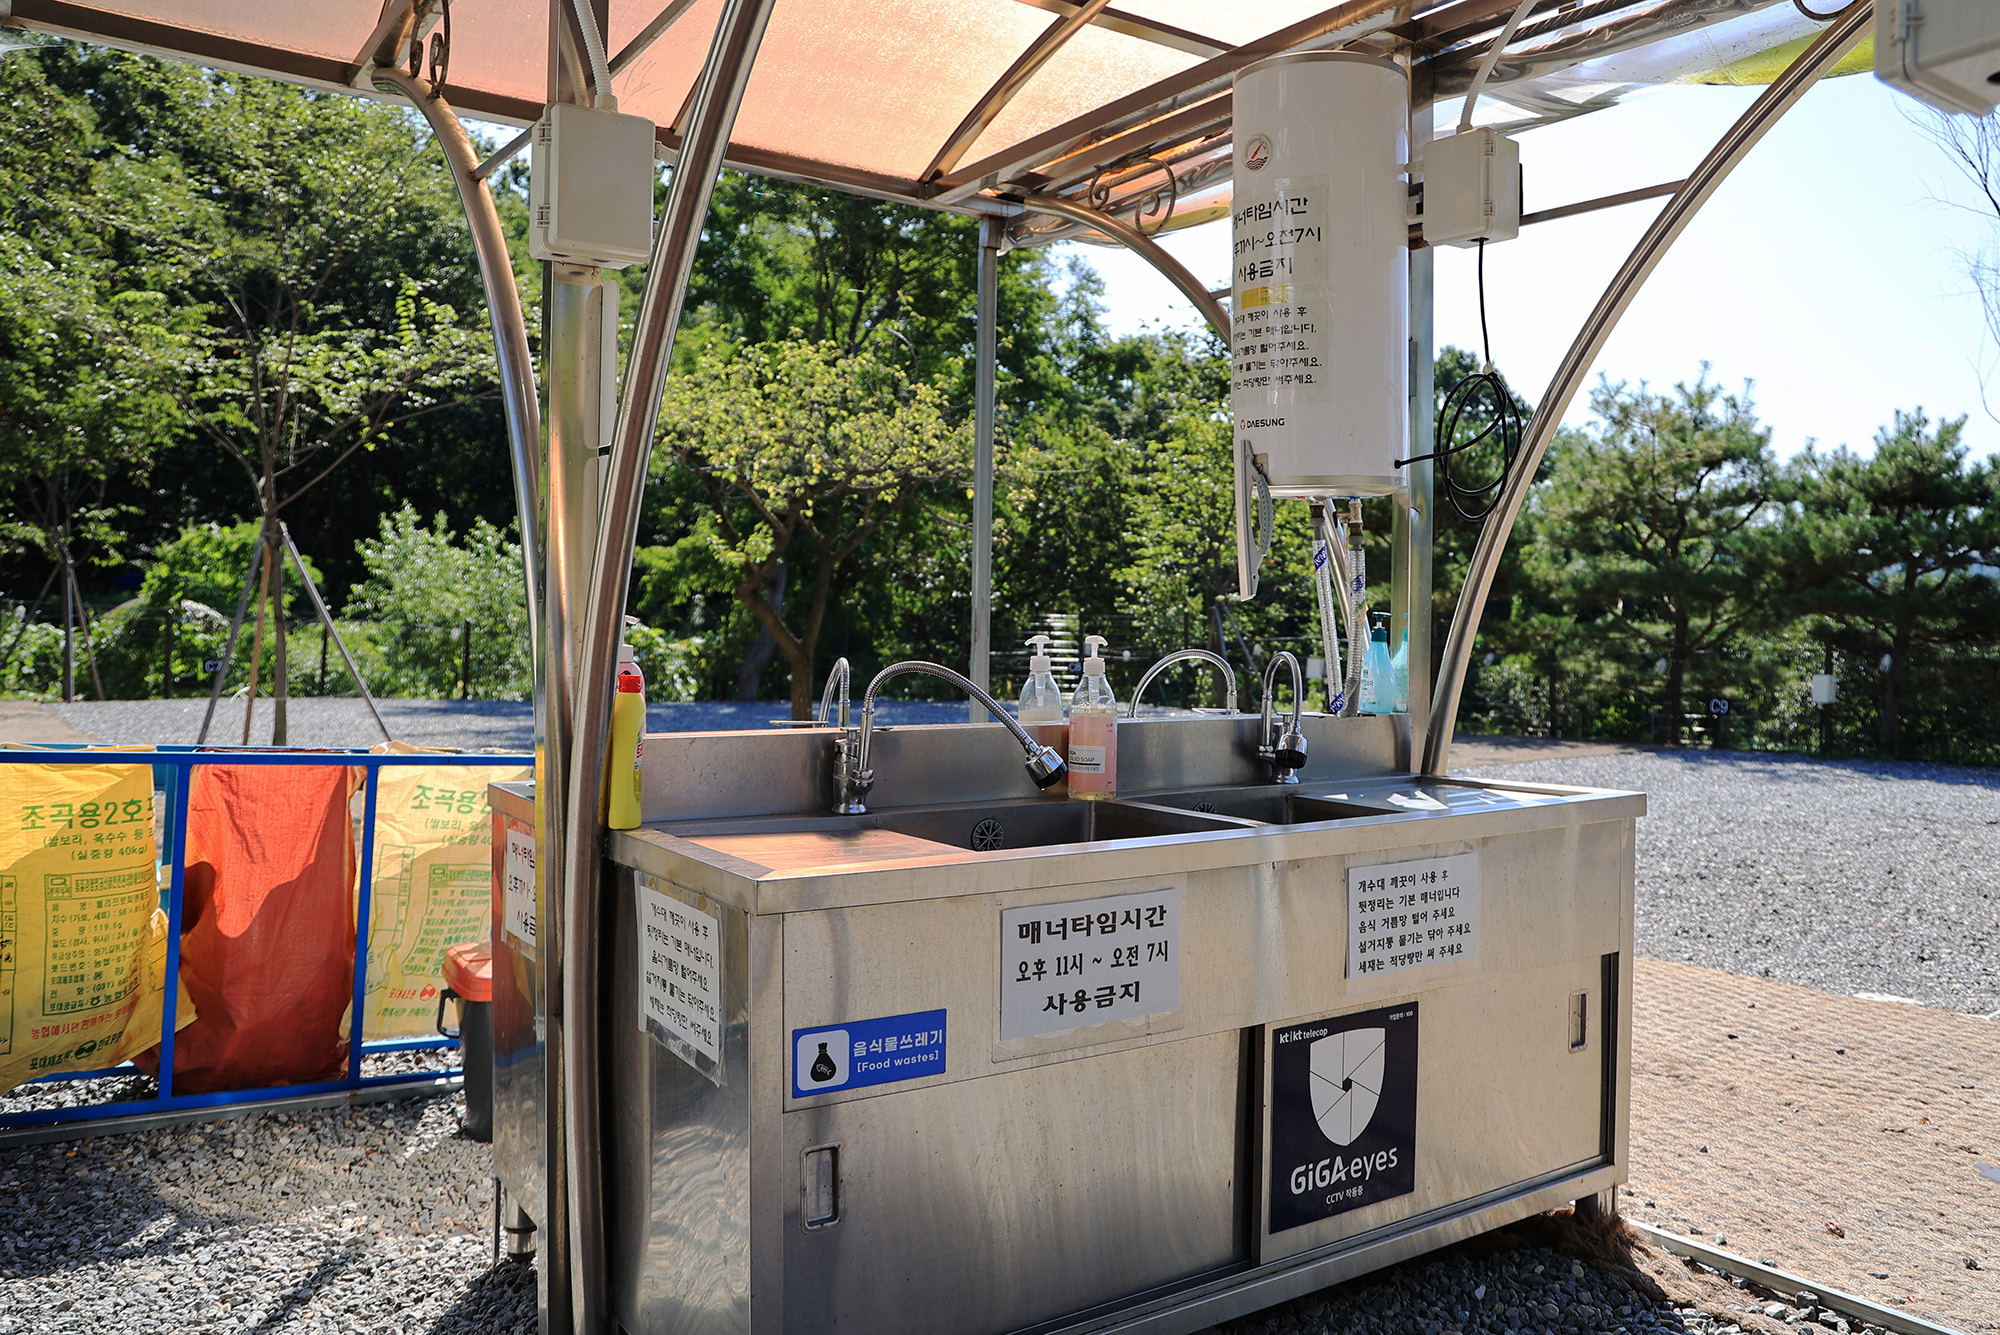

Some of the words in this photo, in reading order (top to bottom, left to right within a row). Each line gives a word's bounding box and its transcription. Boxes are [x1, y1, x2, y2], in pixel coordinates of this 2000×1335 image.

[1238, 257, 1292, 282] 사용금지
[1247, 310, 1269, 321] 깨끗이
[1273, 307, 1291, 318] 사용
[1297, 306, 1307, 316] 후
[1248, 327, 1262, 338] 기본
[1246, 418, 1285, 428] DAESUNG
[205, 660, 224, 673] C7
[1710, 698, 1729, 714] C9
[93, 831, 127, 845] 옥수수
[118, 844, 148, 856] 40kg)
[1358, 877, 1385, 893] 개수대
[1389, 873, 1416, 888] 깨끗이
[1420, 870, 1437, 884] 사용
[1441, 869, 1449, 881] 후
[1358, 897, 1394, 914] 뒷정리는
[1398, 893, 1416, 907] 기본
[1420, 886, 1460, 904] 매너입니다
[650, 902, 667, 922] 개수대
[669, 911, 686, 931] 깨끗이
[688, 919, 700, 936] 사용
[702, 925, 709, 940] 후
[1017, 904, 1168, 944] 매너타임시간
[1358, 919, 1376, 934] 음식
[1381, 914, 1408, 930] 거름망
[1411, 910, 1428, 925] 털어
[1432, 906, 1456, 922] 주세요
[671, 935, 682, 953] 기본
[1358, 936, 1394, 954] 설거지통
[1398, 931, 1423, 947] 물기는
[1427, 927, 1444, 941] 닦아
[1447, 922, 1472, 937] 주세요
[1015, 957, 1047, 983] 오후
[1055, 952, 1083, 977] 11시
[1110, 944, 1139, 969] 오전
[1146, 939, 1169, 963] 7시
[1389, 950, 1423, 967] 적당량만
[1426, 947, 1435, 960] 써
[1439, 943, 1463, 958] 주세요
[1042, 980, 1141, 1016] 사용금지
[853, 1029, 943, 1057] 음식물쓰레기
[1279, 1033, 1289, 1044] kt
[1292, 1029, 1303, 1041] kt
[1303, 1027, 1328, 1040] telecop
[857, 1058, 890, 1073] [Food
[894, 1049, 939, 1067] wastes]
[1326, 1190, 1344, 1205] CCTV
[1345, 1185, 1364, 1198] 작동중
